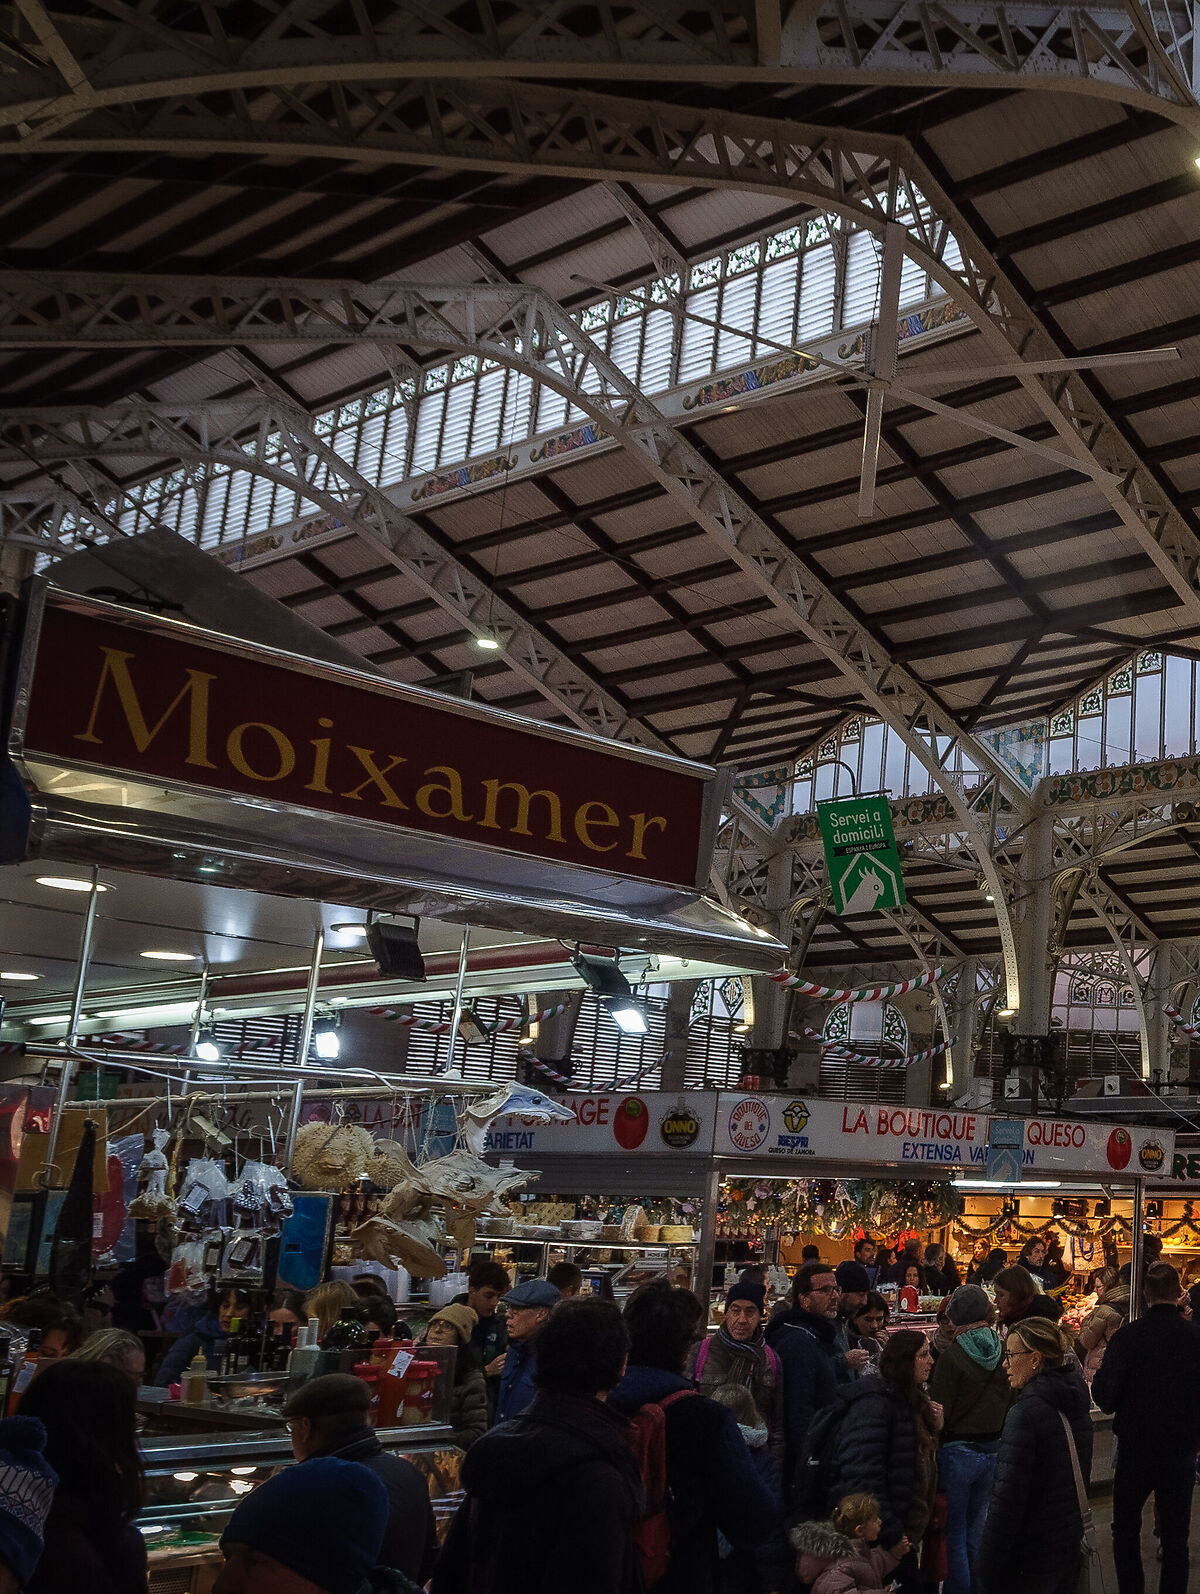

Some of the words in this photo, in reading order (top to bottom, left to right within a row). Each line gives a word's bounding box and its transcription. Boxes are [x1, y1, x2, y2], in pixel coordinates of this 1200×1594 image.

[73, 646, 667, 860] Moixamer
[830, 809, 870, 828] Servei
[873, 811, 881, 822] a
[833, 824, 884, 844] domicili
[733, 1101, 767, 1122] BOUTIQUE
[664, 1120, 696, 1134] ONNO
[841, 1107, 868, 1134] LA
[877, 1110, 975, 1141] BOUTIQUE
[1027, 1121, 1086, 1148] QUESO
[487, 1132, 535, 1149] ARIETAT
[734, 1132, 761, 1149] QUESO
[902, 1142, 962, 1163] EXTENSA
[1141, 1149, 1162, 1160] ONNO
